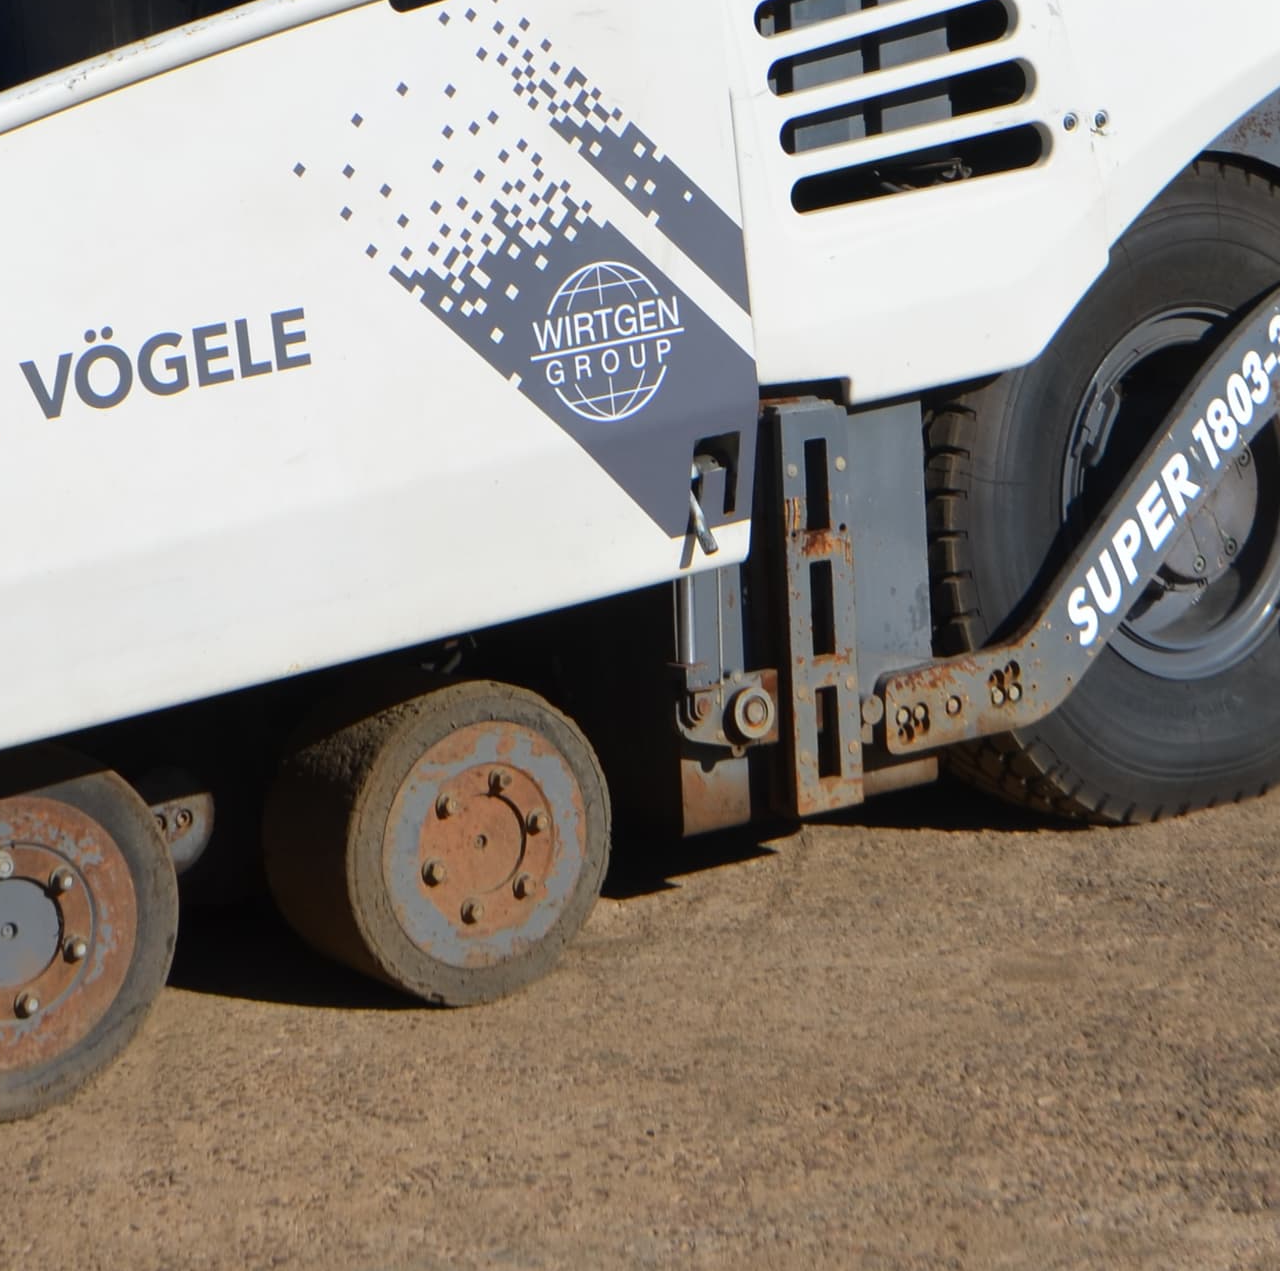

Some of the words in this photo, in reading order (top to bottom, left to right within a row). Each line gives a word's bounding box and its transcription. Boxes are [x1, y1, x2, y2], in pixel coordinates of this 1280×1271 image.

[19, 307, 312, 420] VÖGELE
[532, 295, 680, 353] WIRTGEN
[545, 339, 672, 386] GROUP
[1067, 452, 1201, 647] SUPER
